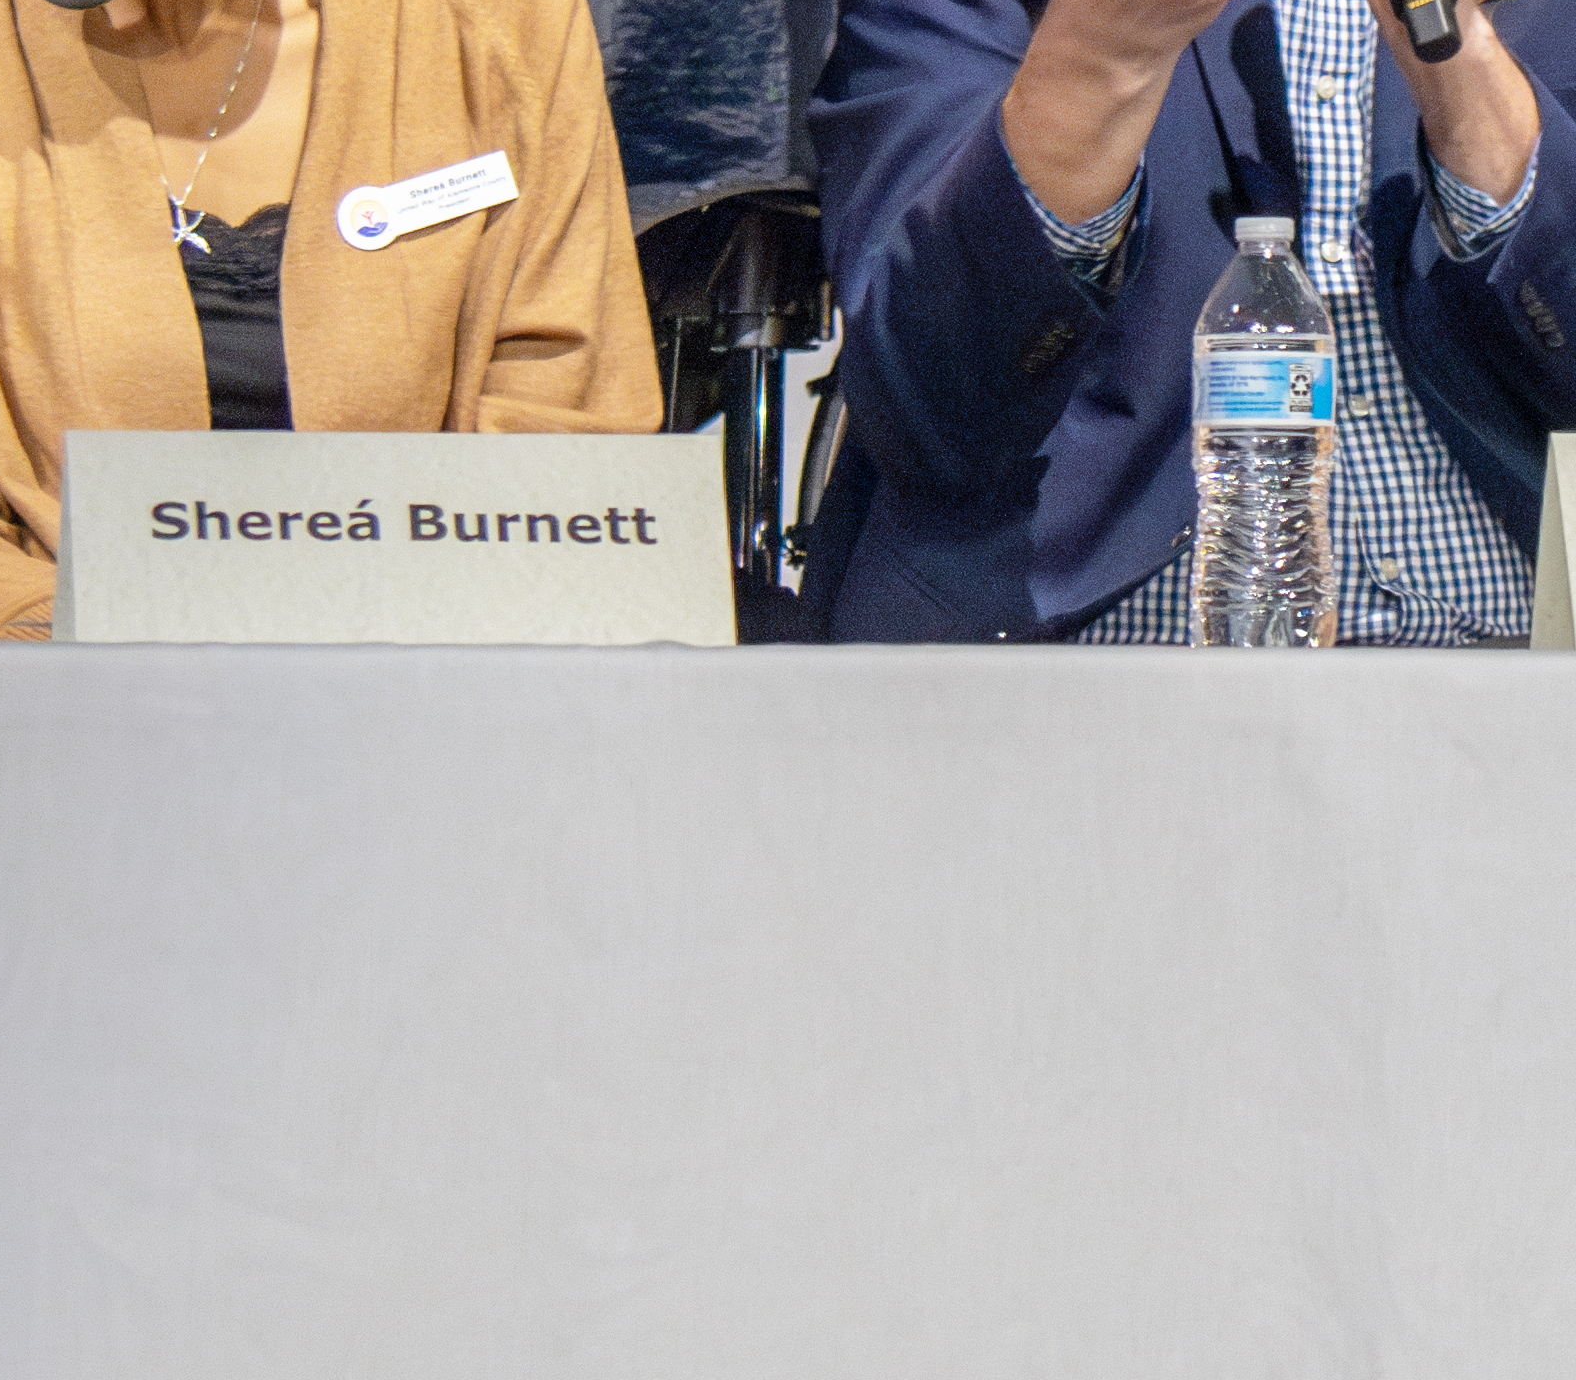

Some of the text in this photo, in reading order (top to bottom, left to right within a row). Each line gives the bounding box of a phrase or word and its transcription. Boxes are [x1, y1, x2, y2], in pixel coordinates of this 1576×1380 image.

[448, 169, 487, 187] Burnett
[150, 498, 658, 546] Shereá Burnett
